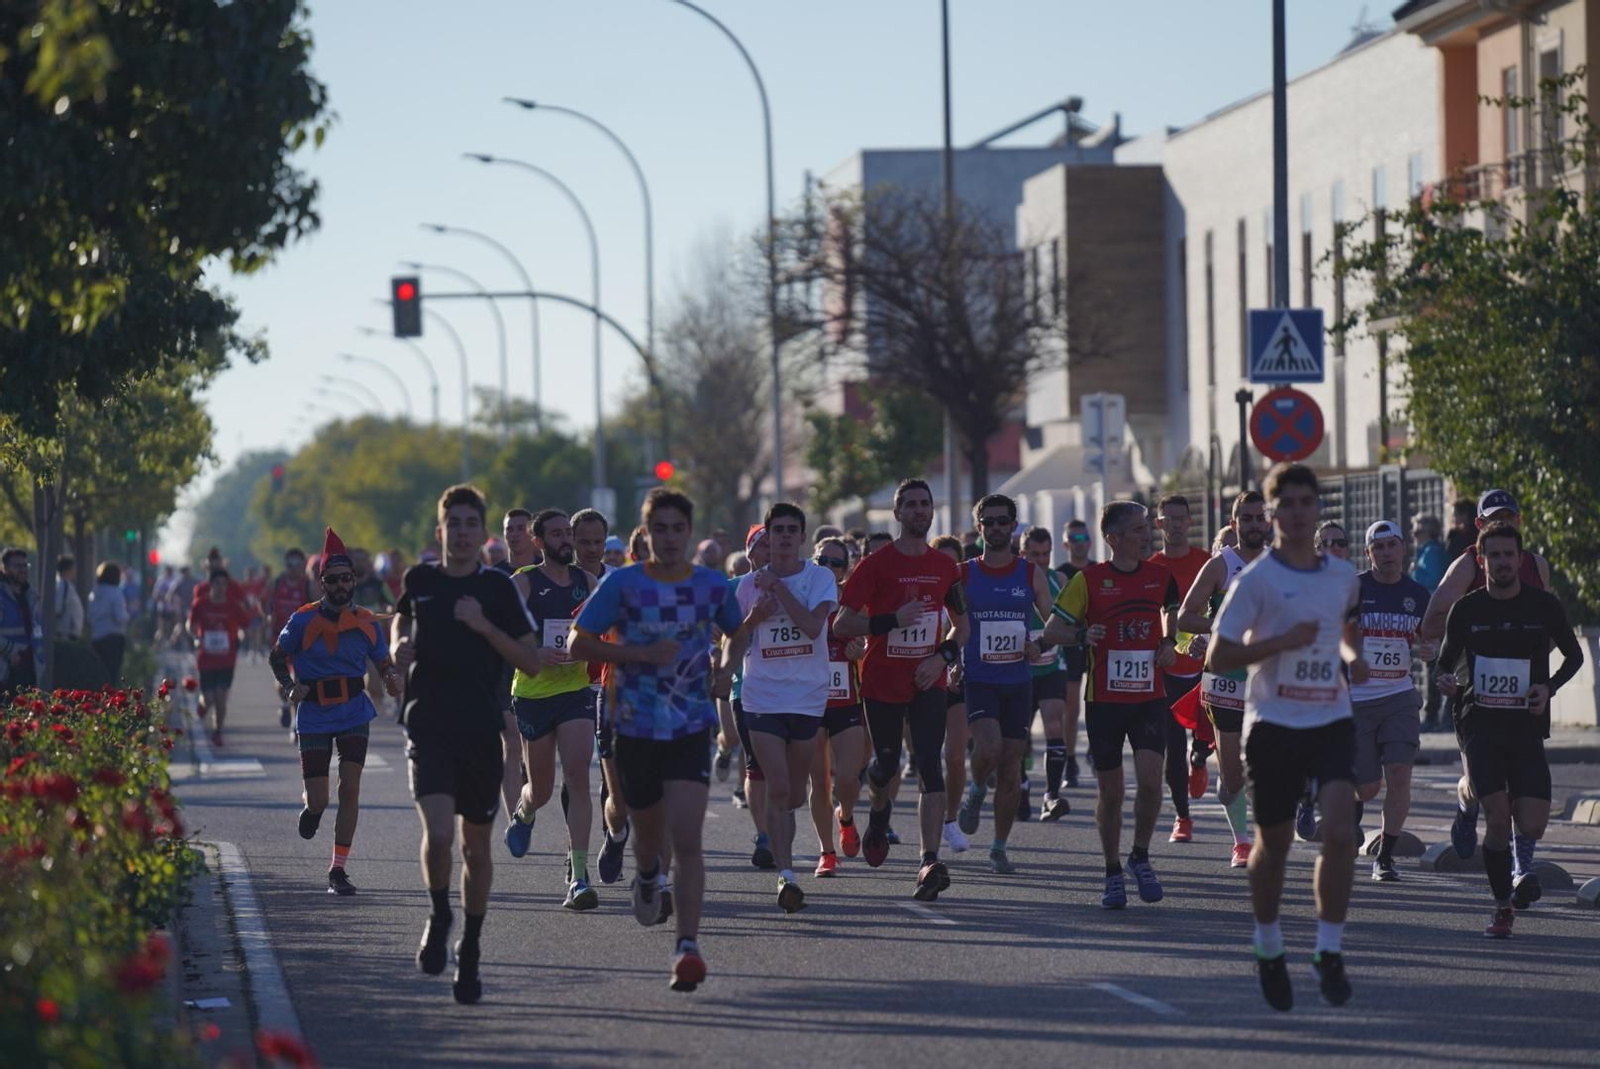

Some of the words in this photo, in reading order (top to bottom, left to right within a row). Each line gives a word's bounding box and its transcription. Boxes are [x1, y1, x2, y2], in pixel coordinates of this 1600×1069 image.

[973, 610, 1026, 620] TROTASIERRA
[555, 635, 568, 648] 9
[770, 627, 801, 643] 785
[901, 627, 927, 642] 111
[986, 634, 1017, 651] 1221
[765, 646, 804, 657] Cruzcampo
[891, 646, 929, 655] Cruzcampo
[1374, 652, 1401, 666] 765
[1114, 659, 1149, 679] 1215
[1295, 660, 1332, 681] 886
[829, 671, 841, 687] 6
[1211, 678, 1237, 693] 199
[1480, 673, 1519, 694] 1228
[1478, 695, 1515, 705] Cruzcampo
